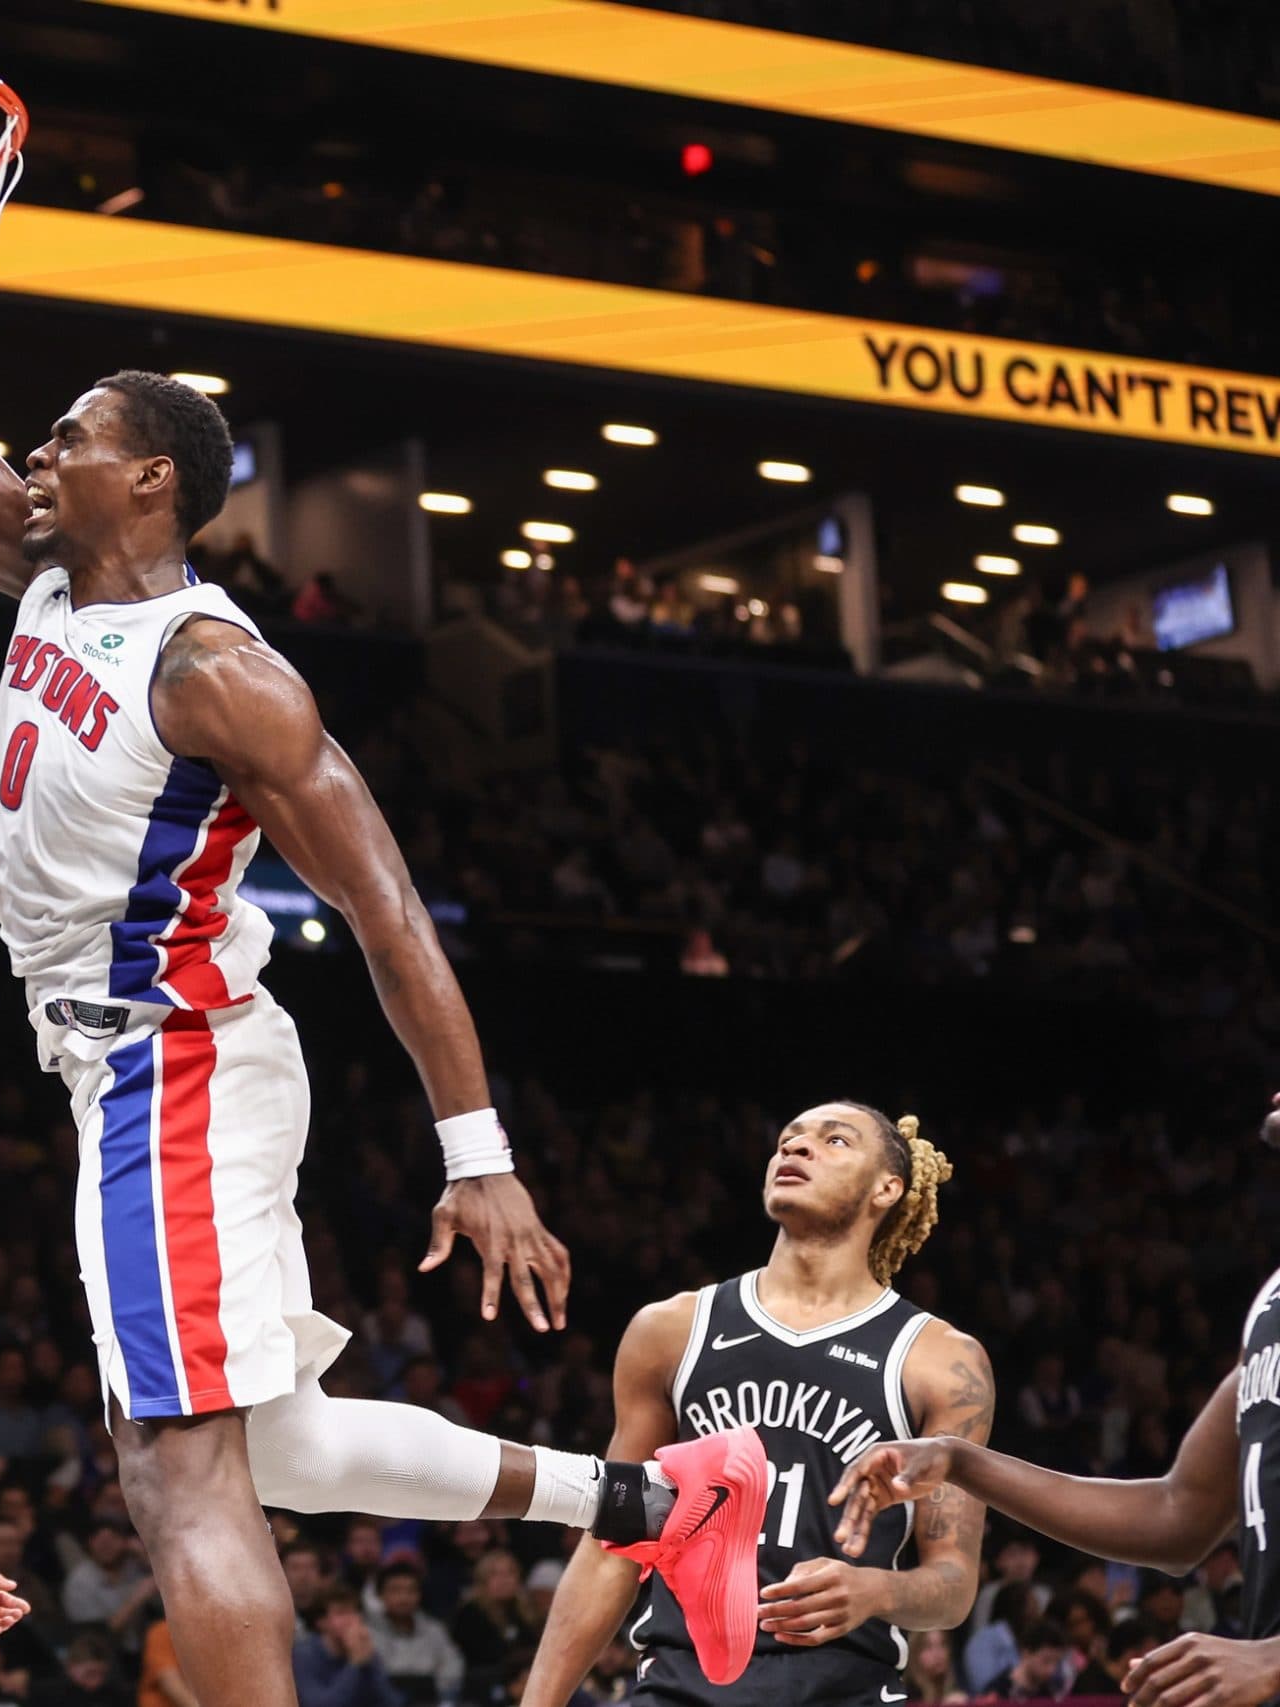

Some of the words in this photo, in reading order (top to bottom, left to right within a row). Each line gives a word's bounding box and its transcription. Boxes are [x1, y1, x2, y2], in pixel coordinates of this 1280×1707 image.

[862, 333, 983, 400] YOU
[1004, 355, 1171, 426] CAN'T
[1188, 380, 1280, 441] REV
[0, 720, 39, 811] 0
[685, 1380, 882, 1464] BROOKLYN
[1243, 1442, 1266, 1551] 4
